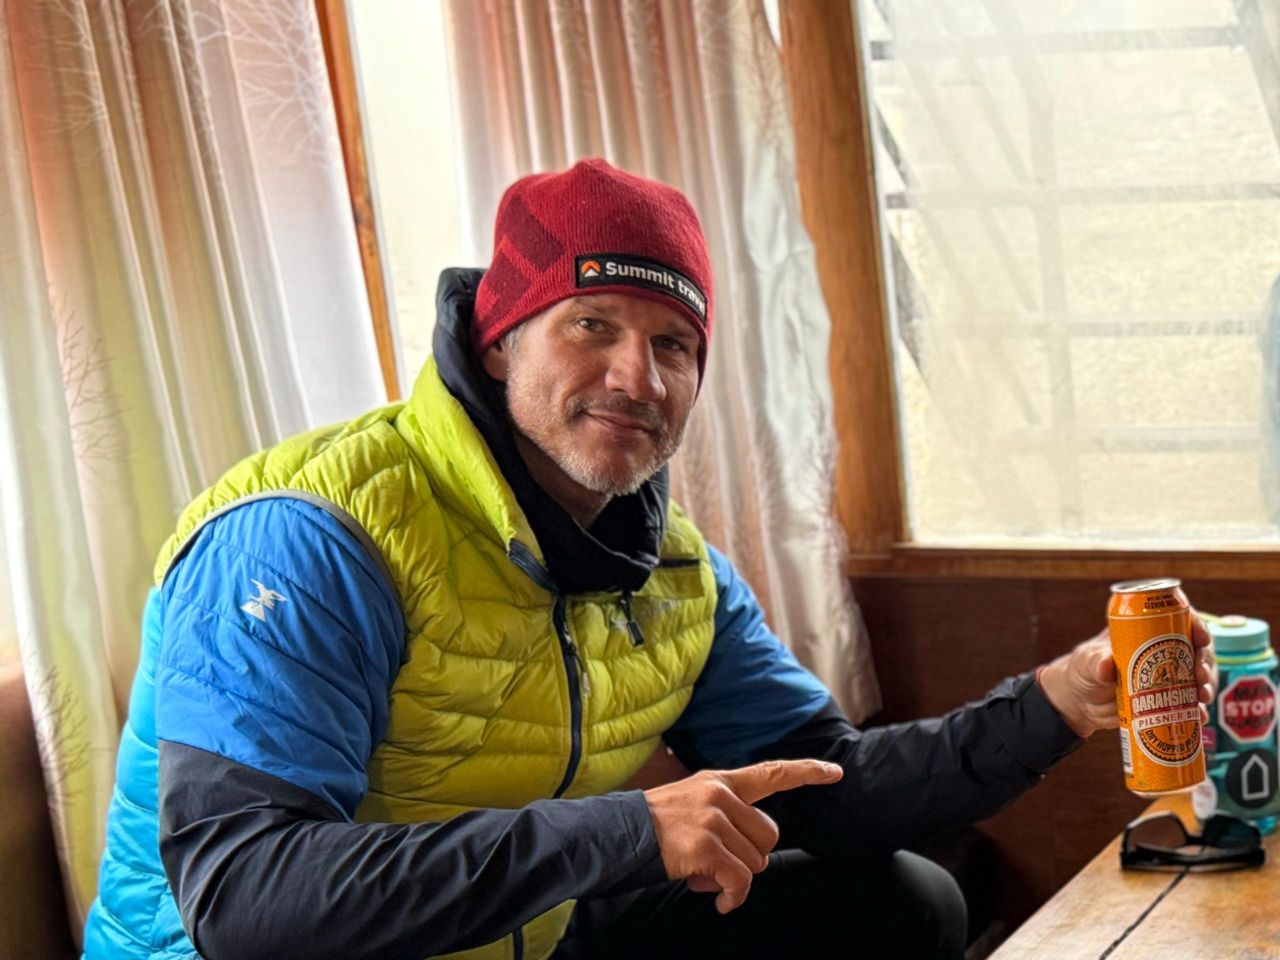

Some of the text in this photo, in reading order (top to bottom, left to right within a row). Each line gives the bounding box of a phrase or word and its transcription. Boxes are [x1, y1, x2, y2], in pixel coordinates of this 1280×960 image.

[605, 261, 676, 289] Summit
[1139, 649, 1166, 684] CRAFT
[1225, 697, 1275, 717] STOP
[1138, 712, 1183, 728] PILSNER
[1145, 729, 1158, 744] DRY
